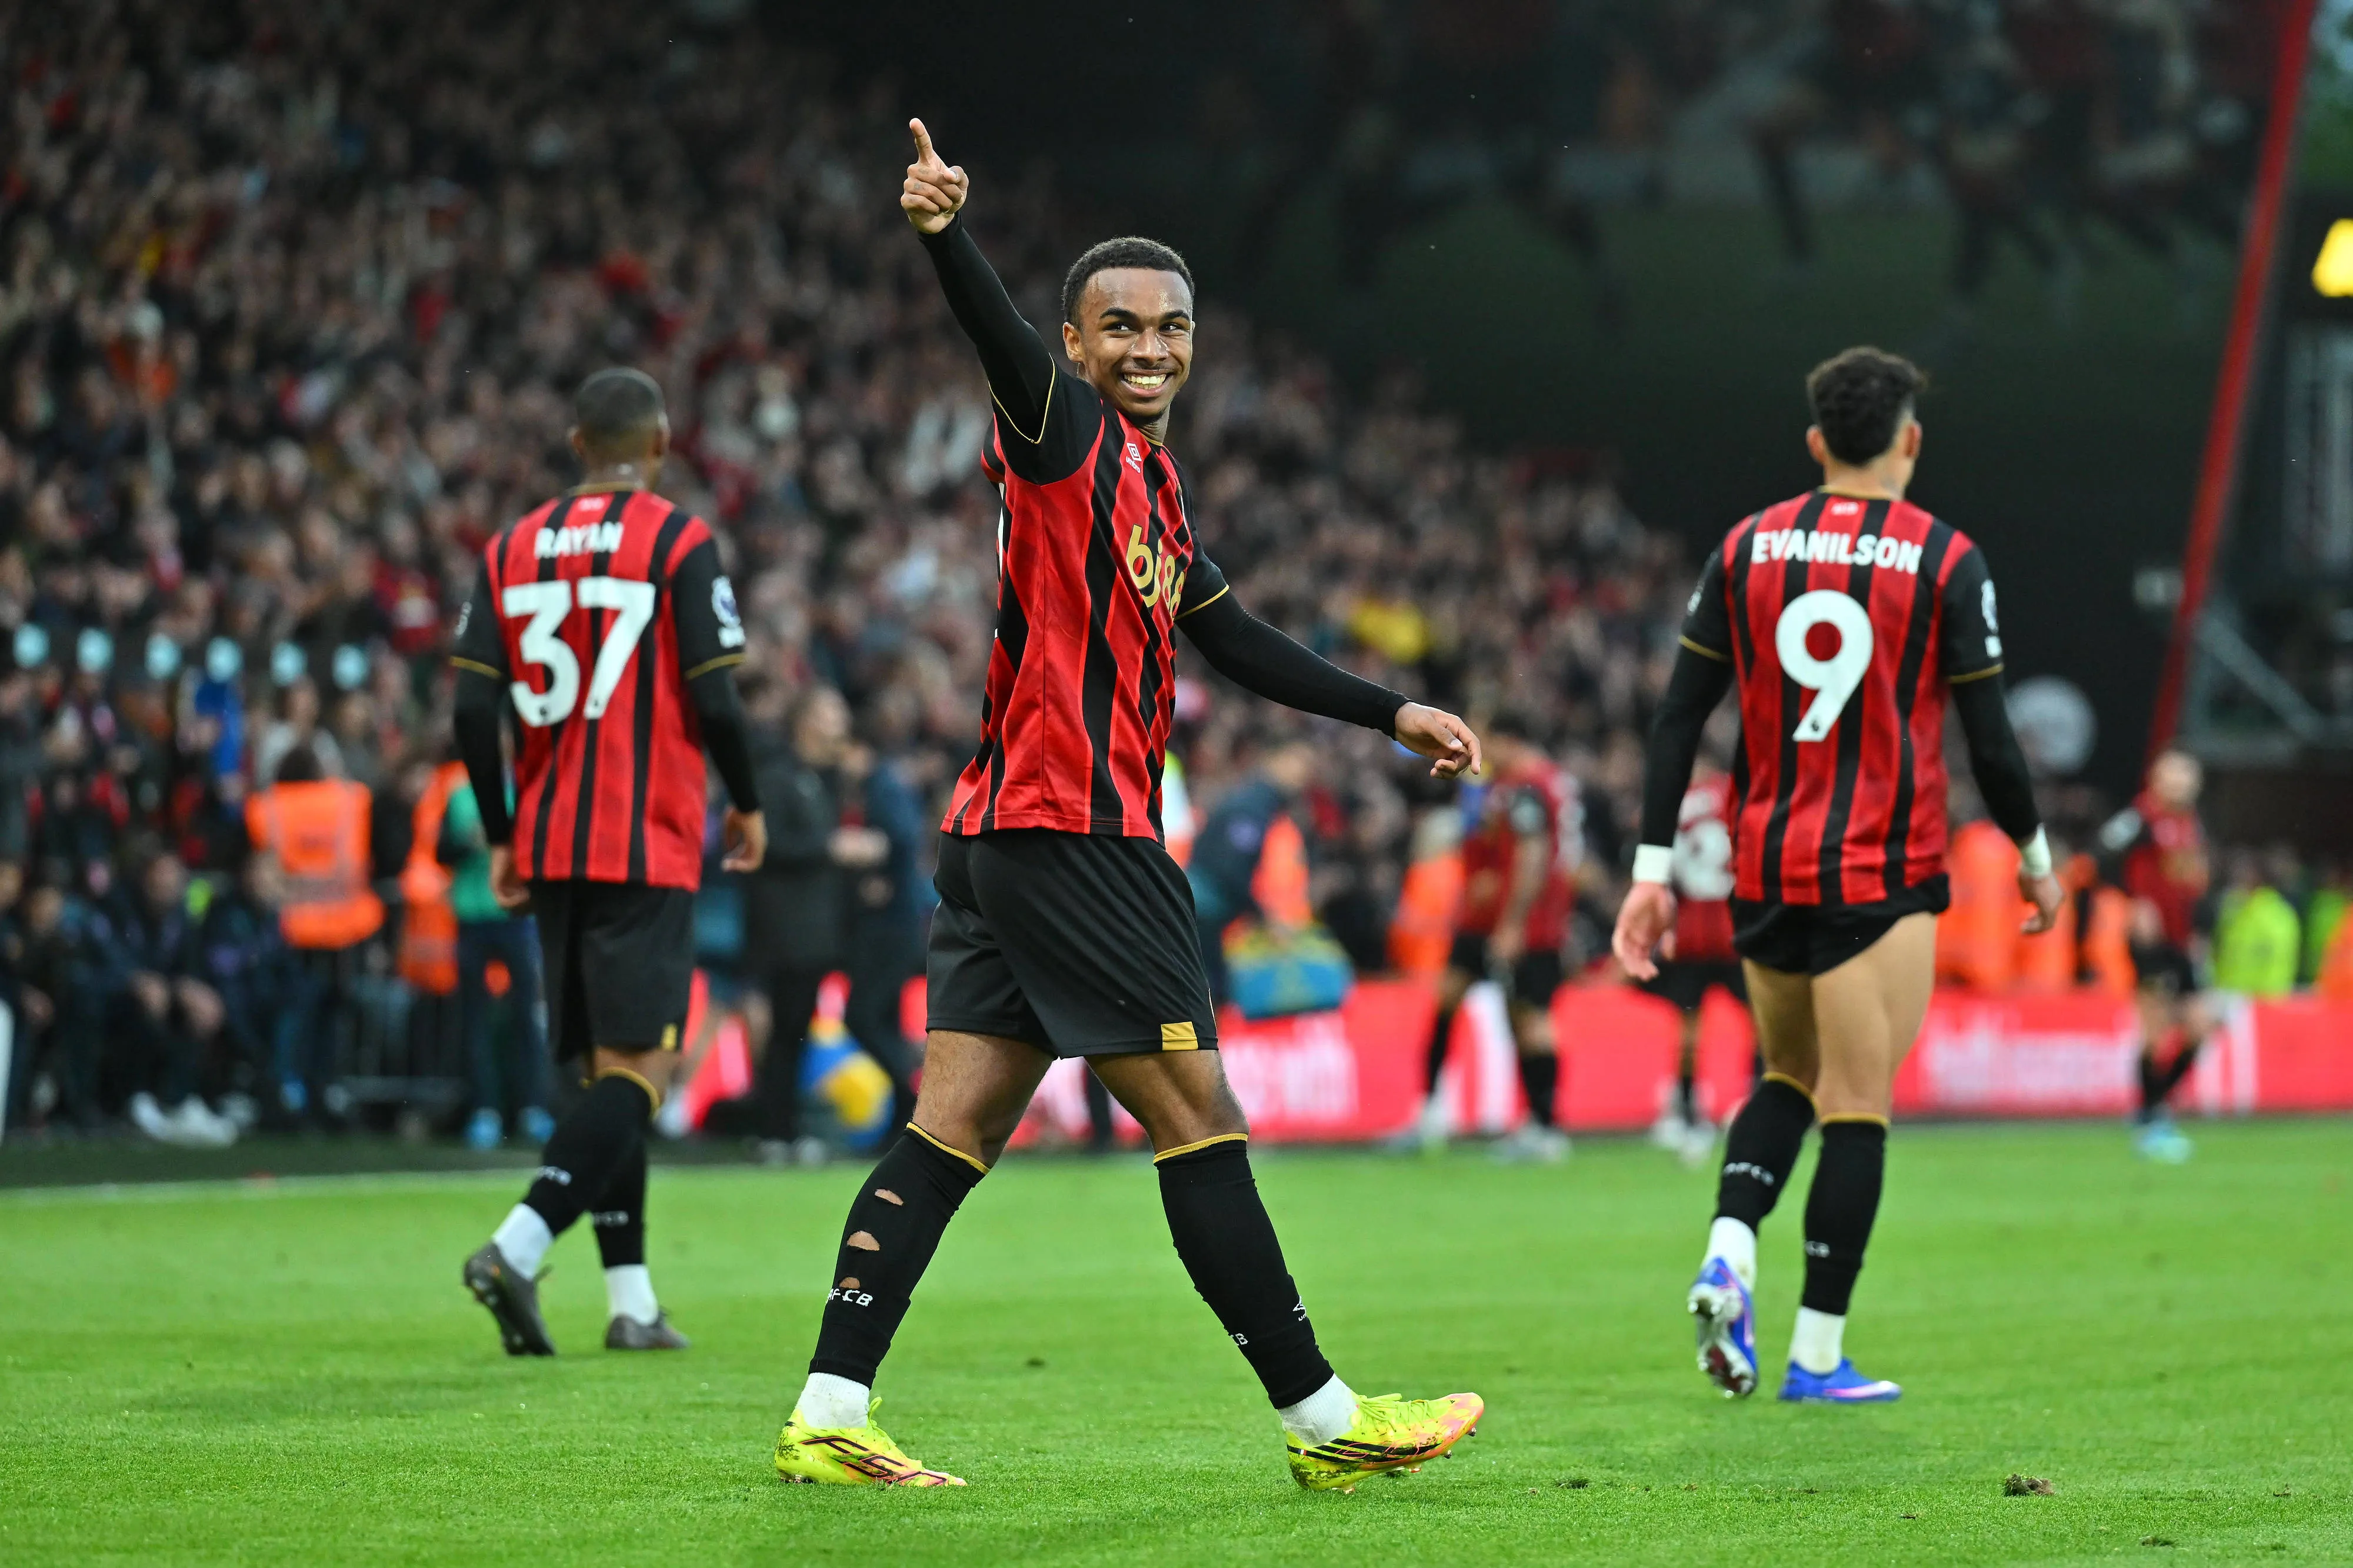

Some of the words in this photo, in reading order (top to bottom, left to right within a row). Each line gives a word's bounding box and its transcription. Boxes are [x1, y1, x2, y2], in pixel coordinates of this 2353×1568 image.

[1125, 456, 1141, 473] umbro
[534, 521, 625, 559] RAYAN
[1126, 523, 1186, 622] bj88
[1751, 528, 1923, 575] EVANILSON
[502, 576, 656, 728] 37
[1774, 589, 1875, 742] 9
